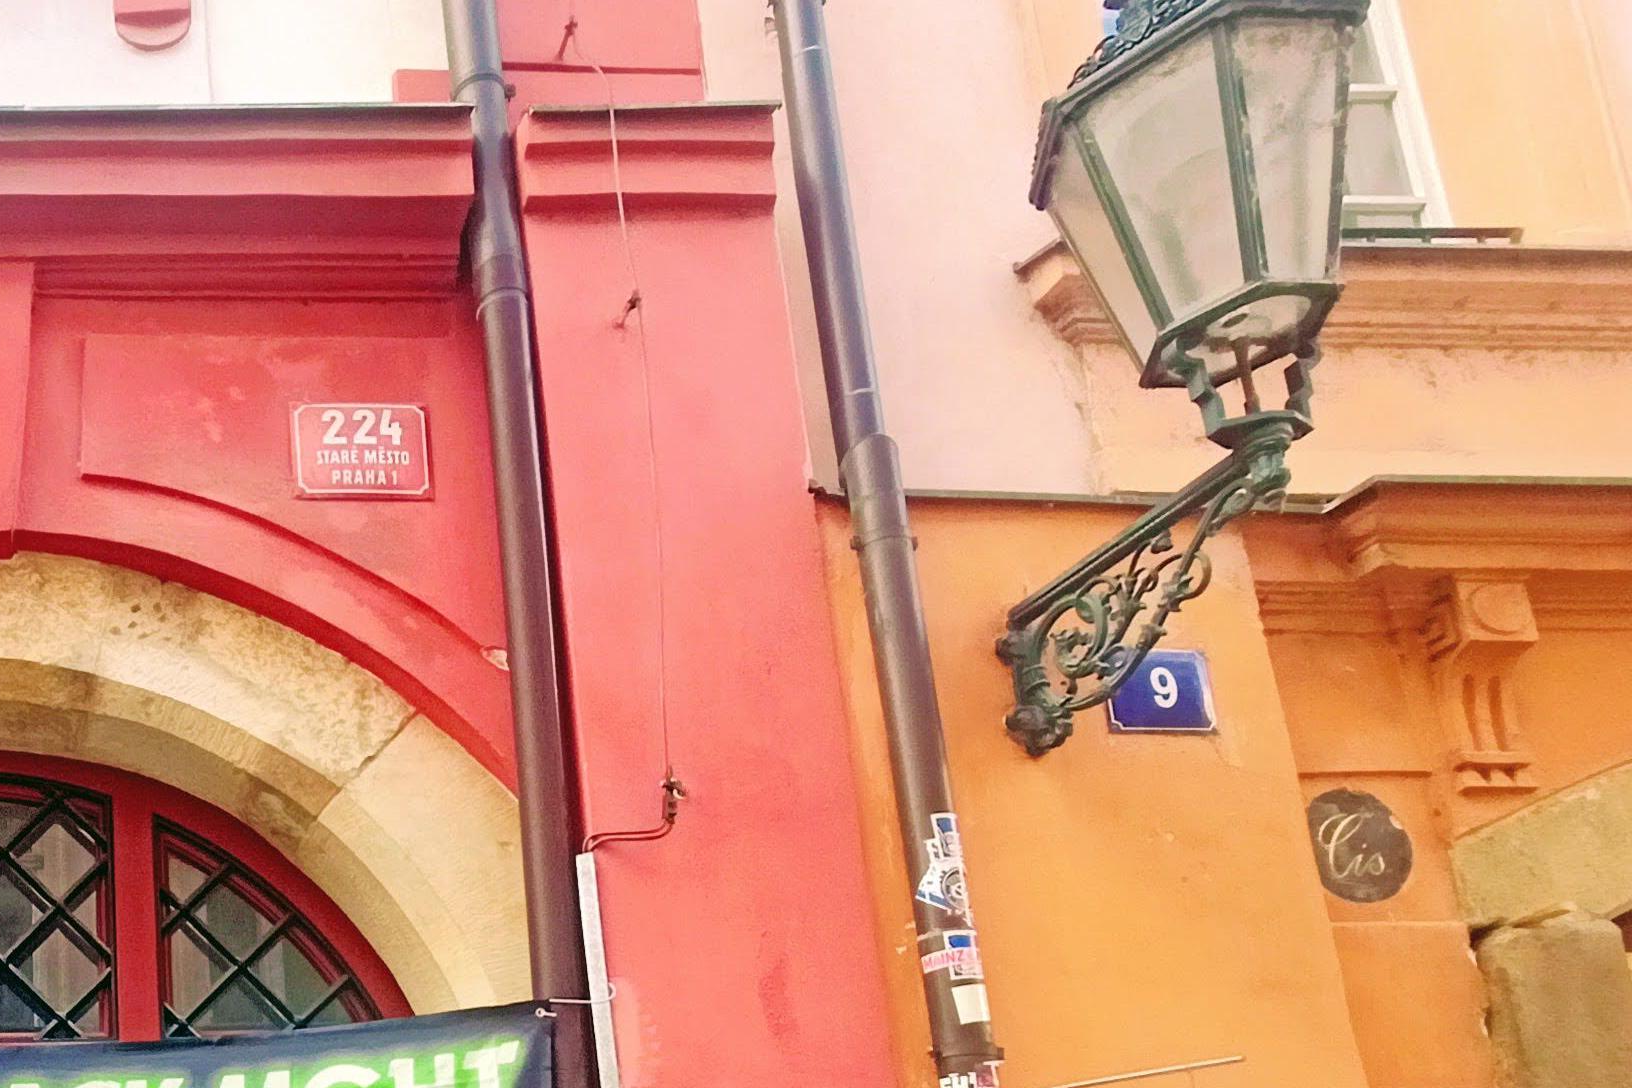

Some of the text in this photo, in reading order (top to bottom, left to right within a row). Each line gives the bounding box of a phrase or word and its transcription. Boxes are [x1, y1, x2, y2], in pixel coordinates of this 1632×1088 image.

[321, 408, 403, 445] 224
[316, 446, 410, 465] STARÉ MĚSTO
[331, 469, 398, 485] PRAHA 1
[1148, 666, 1179, 709] 9
